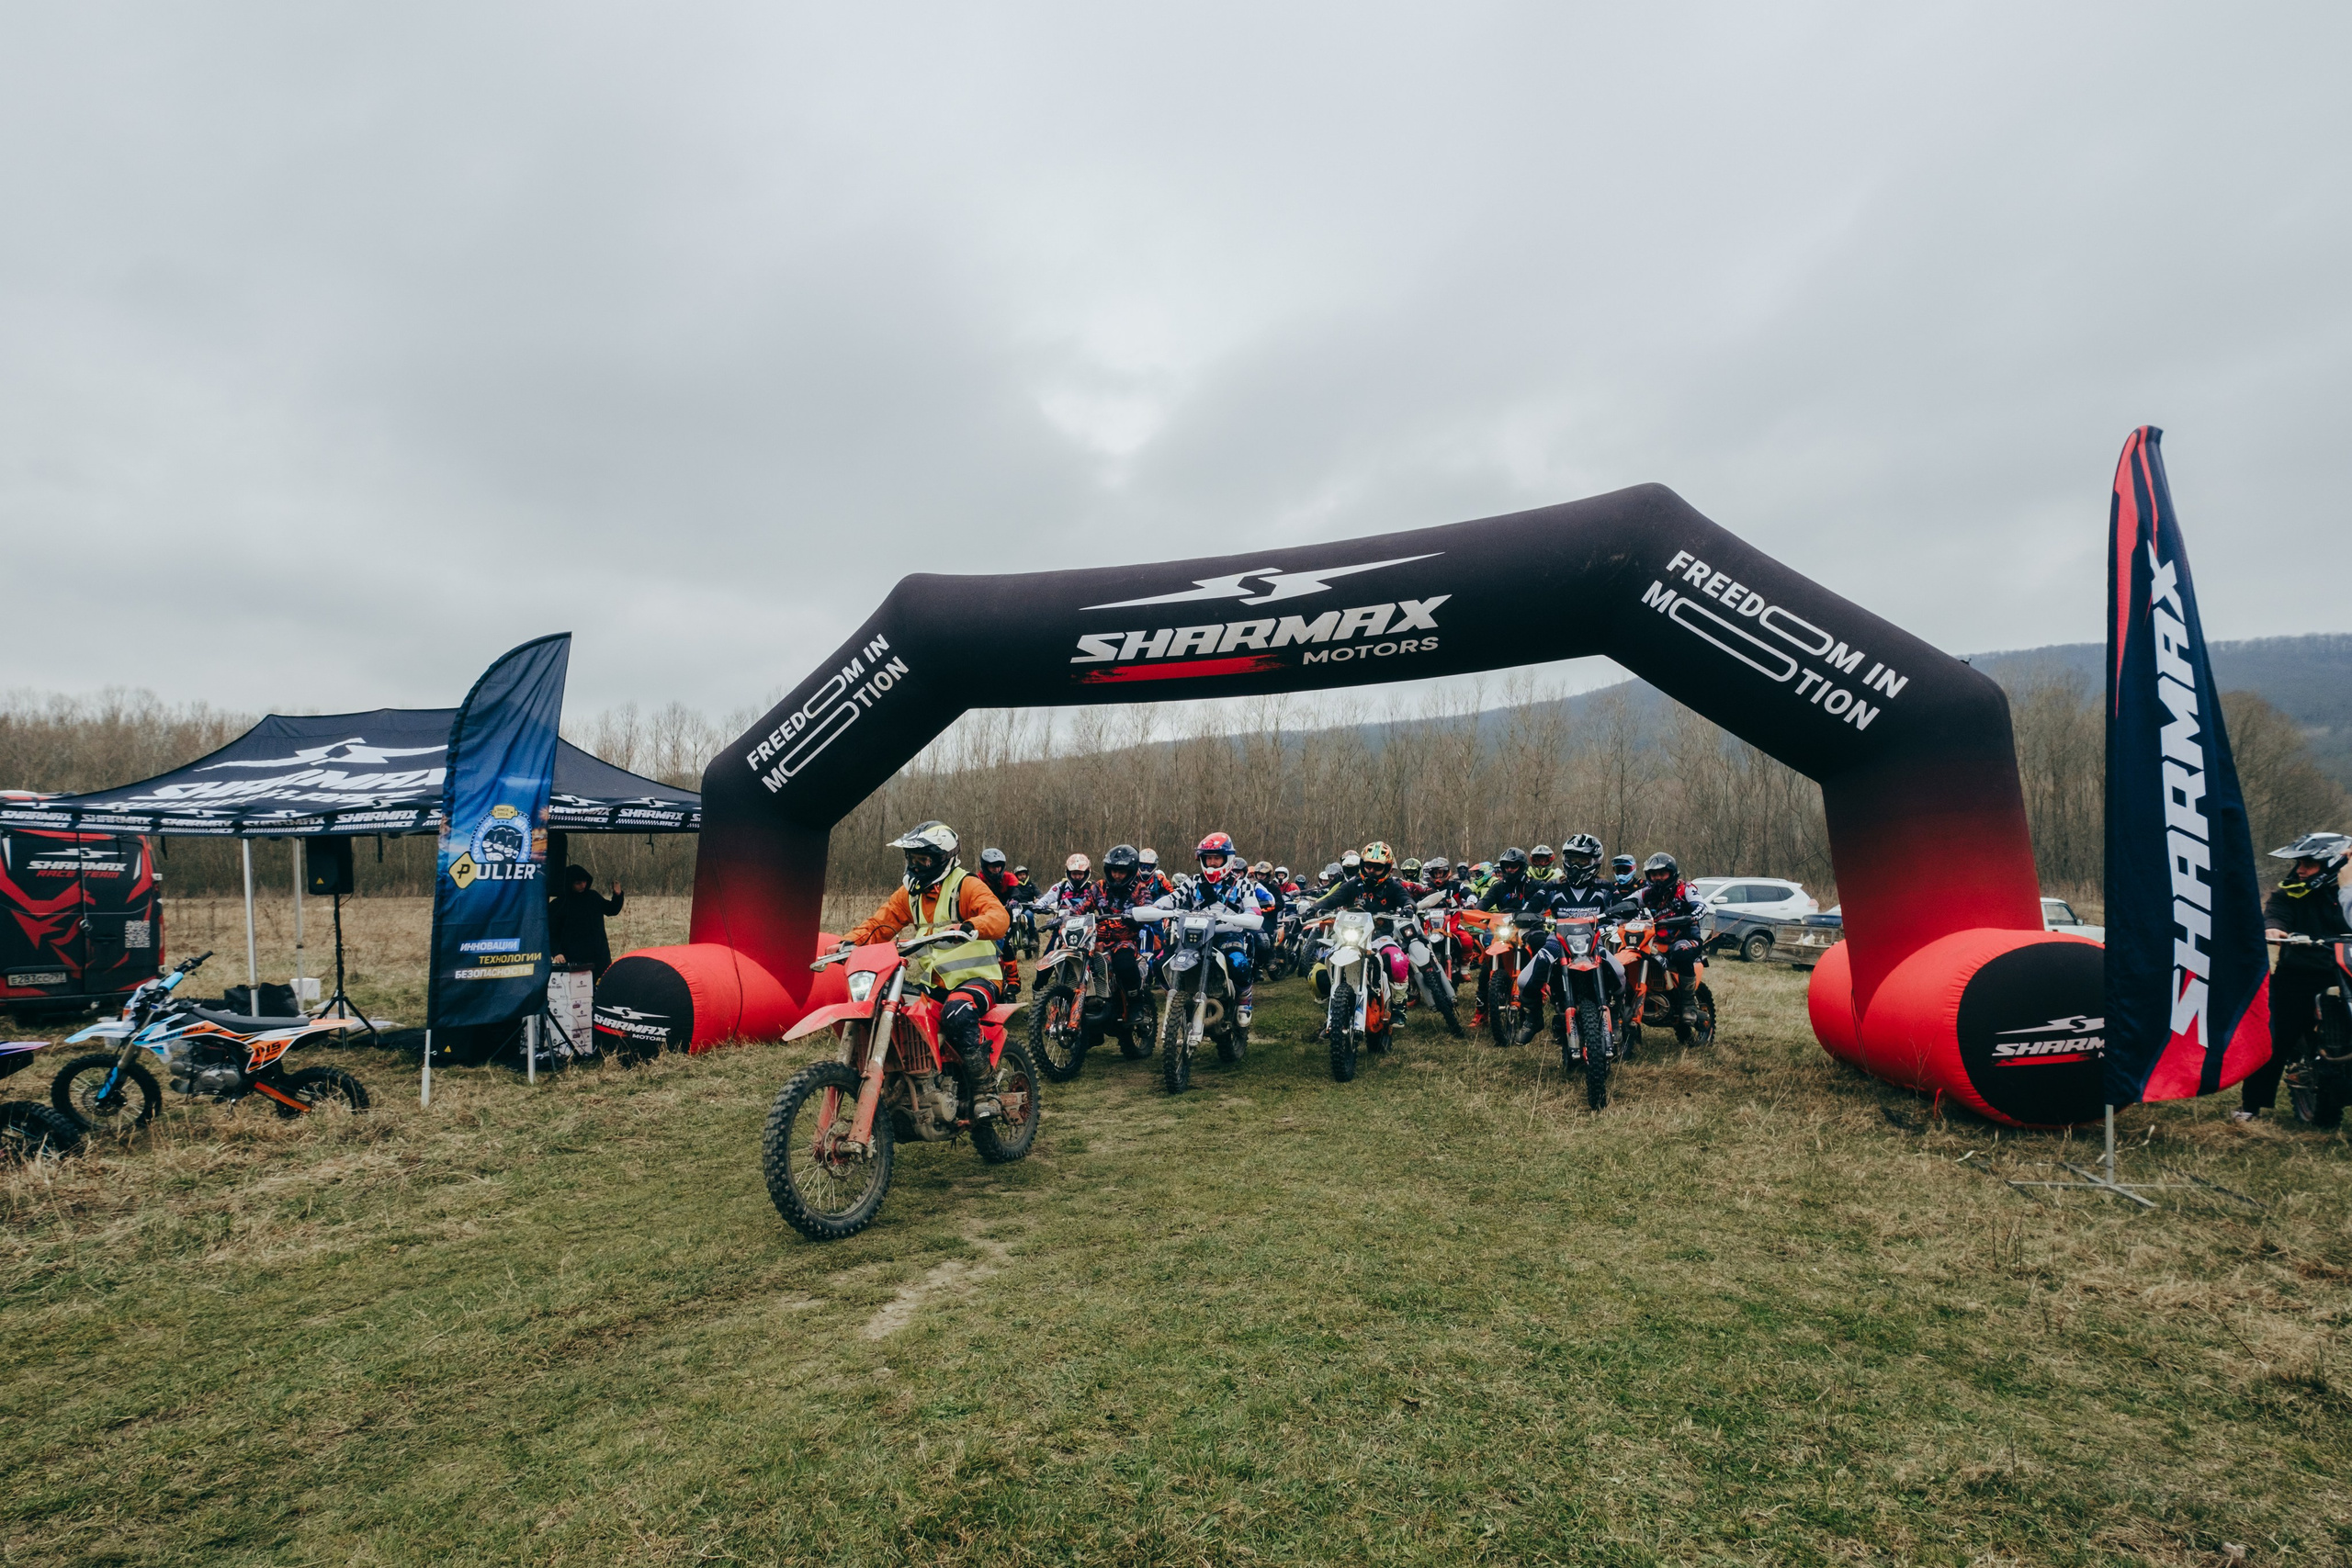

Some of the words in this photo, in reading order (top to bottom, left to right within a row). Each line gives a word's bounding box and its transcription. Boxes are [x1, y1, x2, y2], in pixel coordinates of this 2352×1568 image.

[1069, 593, 1453, 663] SHARMAX
[1666, 549, 1865, 674] FREEDOM
[1862, 662, 1909, 699] IN
[1302, 636, 1439, 665] MOTORS
[1641, 580, 1881, 731] MOTION
[746, 657, 865, 772] FREEDOM
[863, 633, 890, 663] IN
[761, 655, 910, 794] MOTION
[2146, 538, 2212, 1048] SHARMAX
[0, 810, 72, 821] SHARMAX
[334, 809, 419, 823] SHARMAX
[548, 806, 614, 816] HARMAX
[617, 807, 684, 821] SHARMAX
[81, 814, 153, 825] SHARMAX
[160, 818, 233, 827] SHARMAX
[27, 861, 128, 872] SHARMAX
[85, 871, 120, 879] TEAM
[459, 941, 517, 952] ИННОВАЦИИ
[479, 953, 542, 964] ТЕХНОЛОГИИ
[455, 966, 531, 979] БЕЗОПАСНОСТЬ
[594, 1013, 672, 1037] SHARMAX
[631, 1033, 667, 1043] MOTORS
[1992, 1036, 2105, 1056] SHARM
